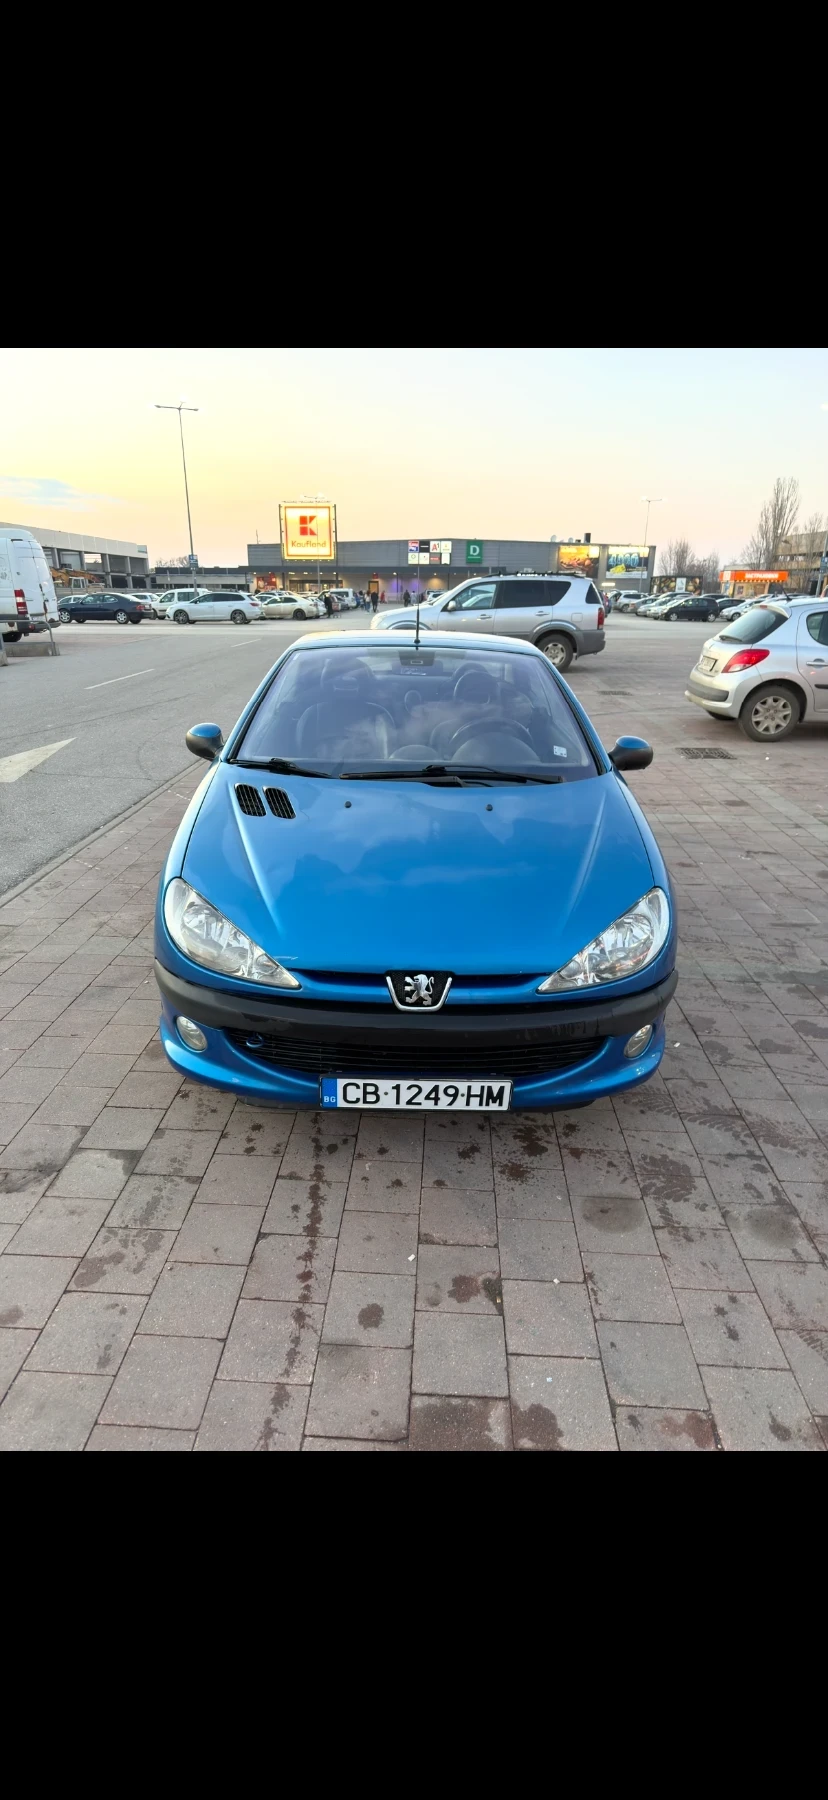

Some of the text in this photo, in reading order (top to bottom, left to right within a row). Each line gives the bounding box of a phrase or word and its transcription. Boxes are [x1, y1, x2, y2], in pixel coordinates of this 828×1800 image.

[299, 515, 317, 536] K
[291, 540, 327, 548] Kaufland
[469, 545, 480, 556] D
